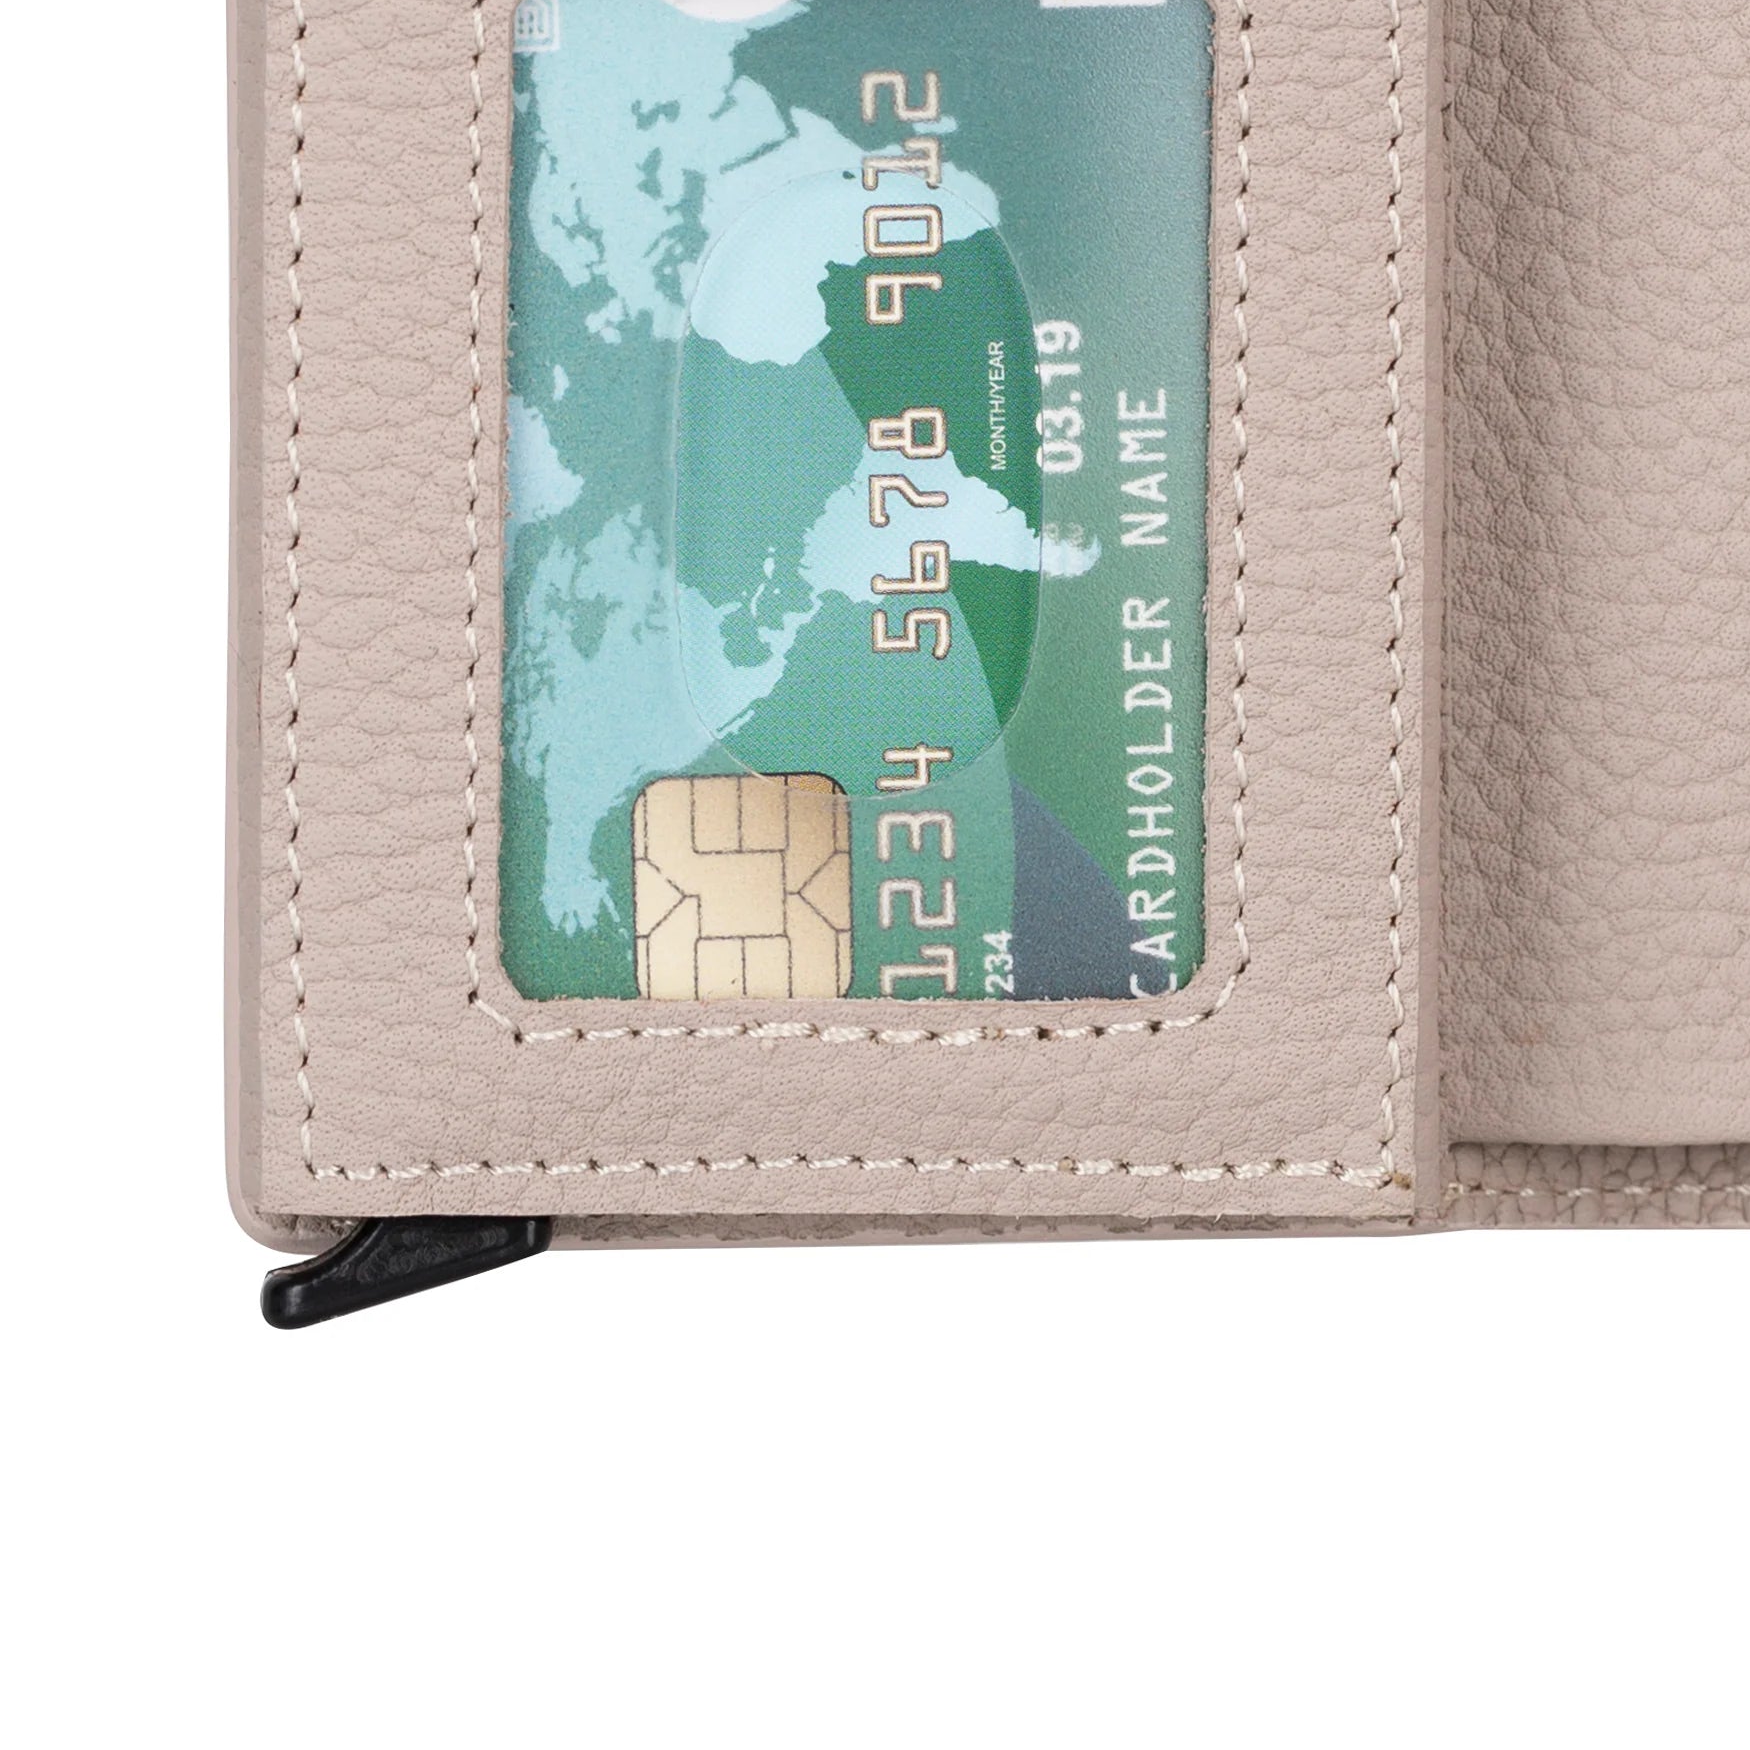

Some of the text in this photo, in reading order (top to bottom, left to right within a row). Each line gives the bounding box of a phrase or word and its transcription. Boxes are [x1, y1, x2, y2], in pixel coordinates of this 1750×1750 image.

[859, 68, 959, 997] 1234 5678 9012
[988, 340, 1006, 472] MONTH/YEAR
[1035, 319, 1085, 475] 03.19
[1116, 387, 1178, 999] CARDHOLDER NAME
